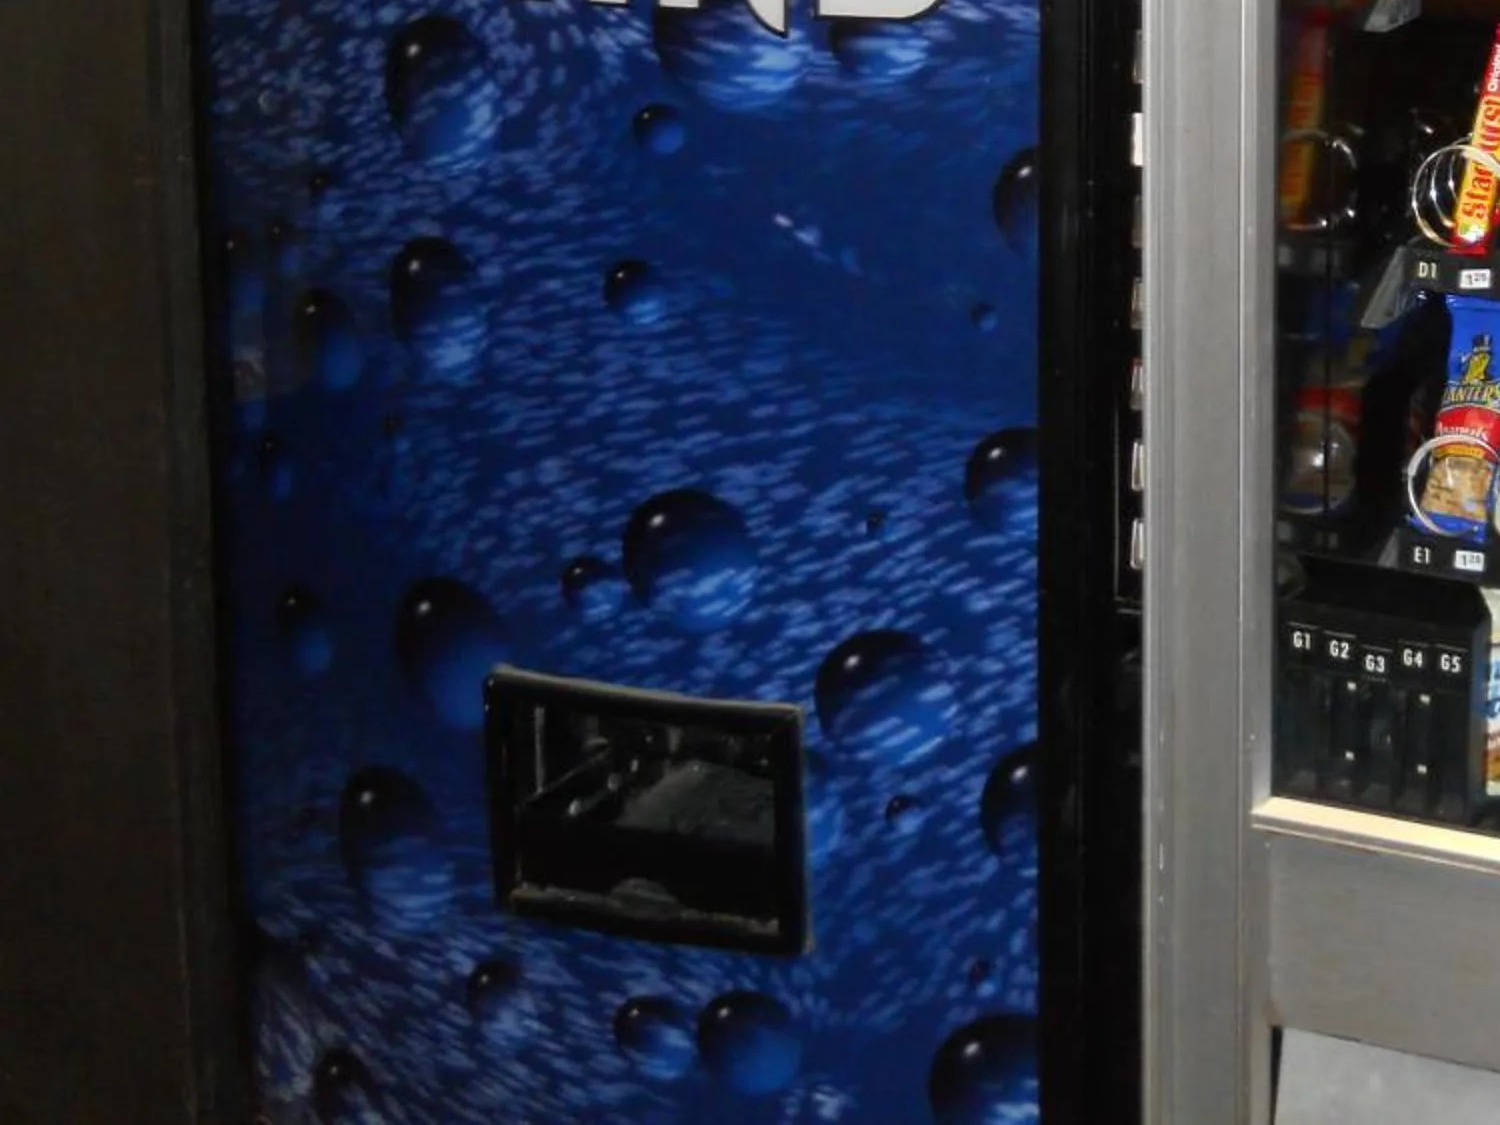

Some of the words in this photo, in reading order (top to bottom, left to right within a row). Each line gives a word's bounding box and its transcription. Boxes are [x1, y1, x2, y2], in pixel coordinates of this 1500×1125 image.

[1418, 261, 1438, 279] D1
[1414, 547, 1431, 565] E1
[1292, 630, 1312, 651] G1
[1329, 639, 1350, 661] G2
[1364, 653, 1386, 674] G3
[1402, 647, 1424, 668] G4
[1440, 653, 1462, 674] G5
